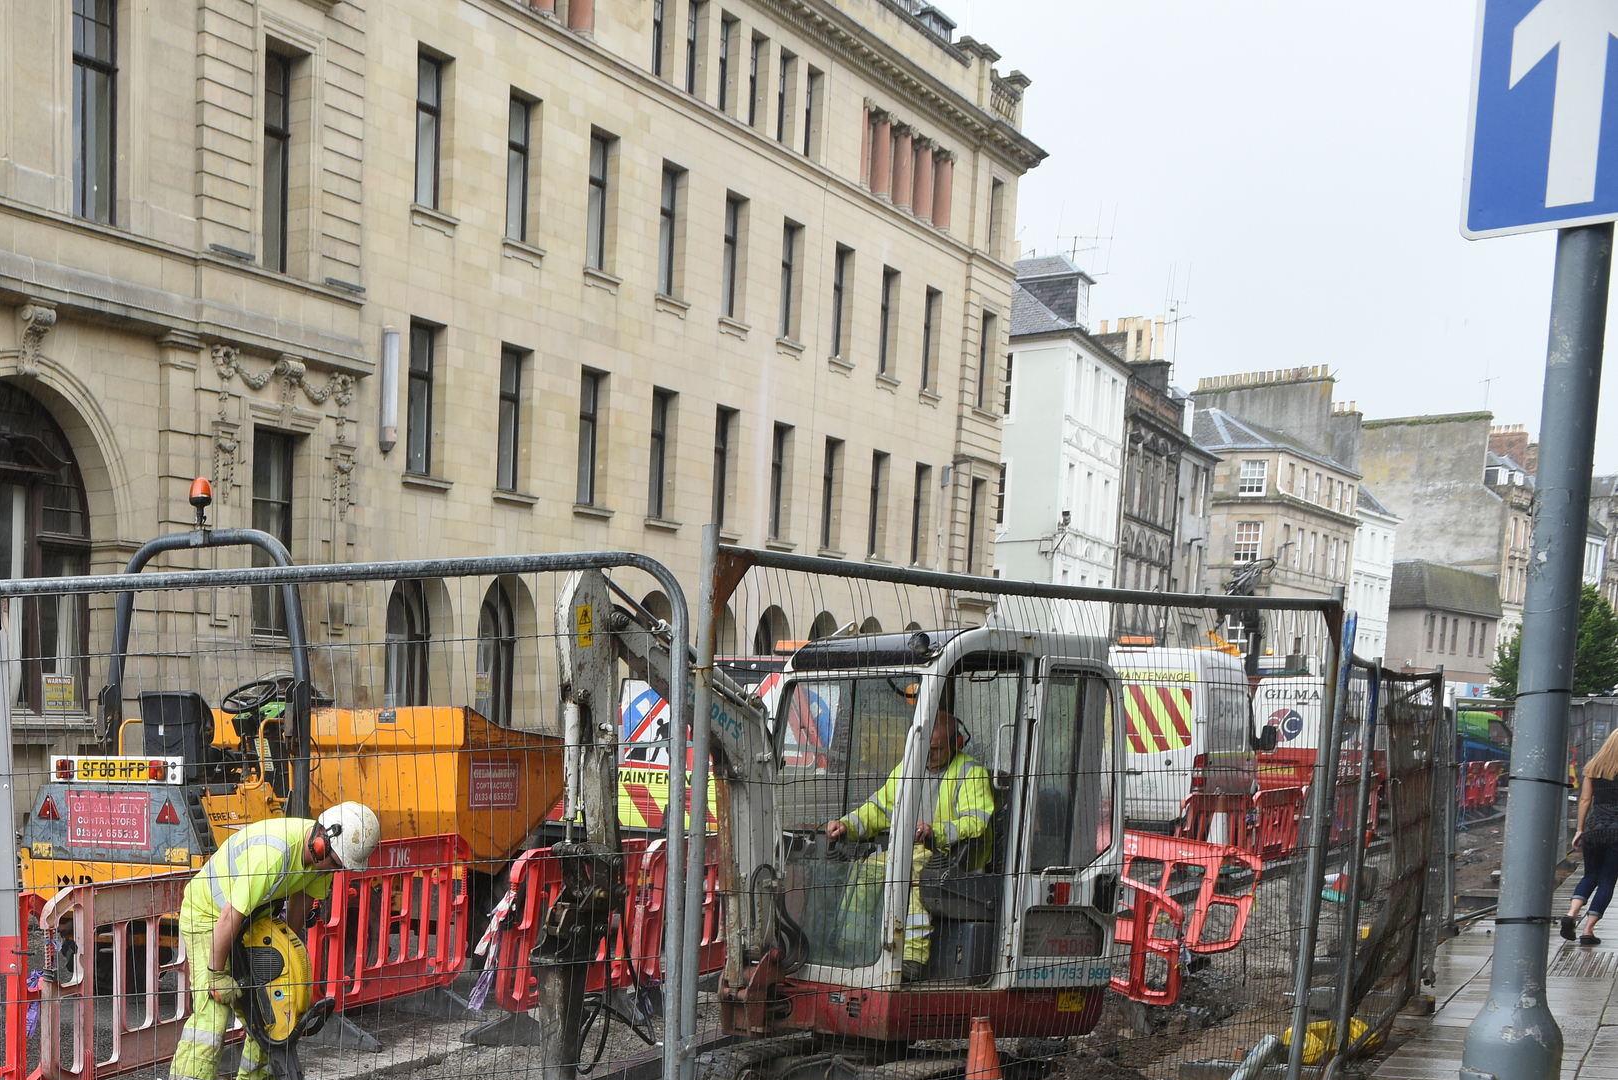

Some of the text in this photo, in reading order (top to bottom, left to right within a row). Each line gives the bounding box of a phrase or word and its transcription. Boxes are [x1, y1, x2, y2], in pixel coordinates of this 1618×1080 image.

[83, 762, 145, 778] SF08 HFP
[208, 812, 232, 821] TEREX
[1018, 967, 1111, 980] 01501 753 999
